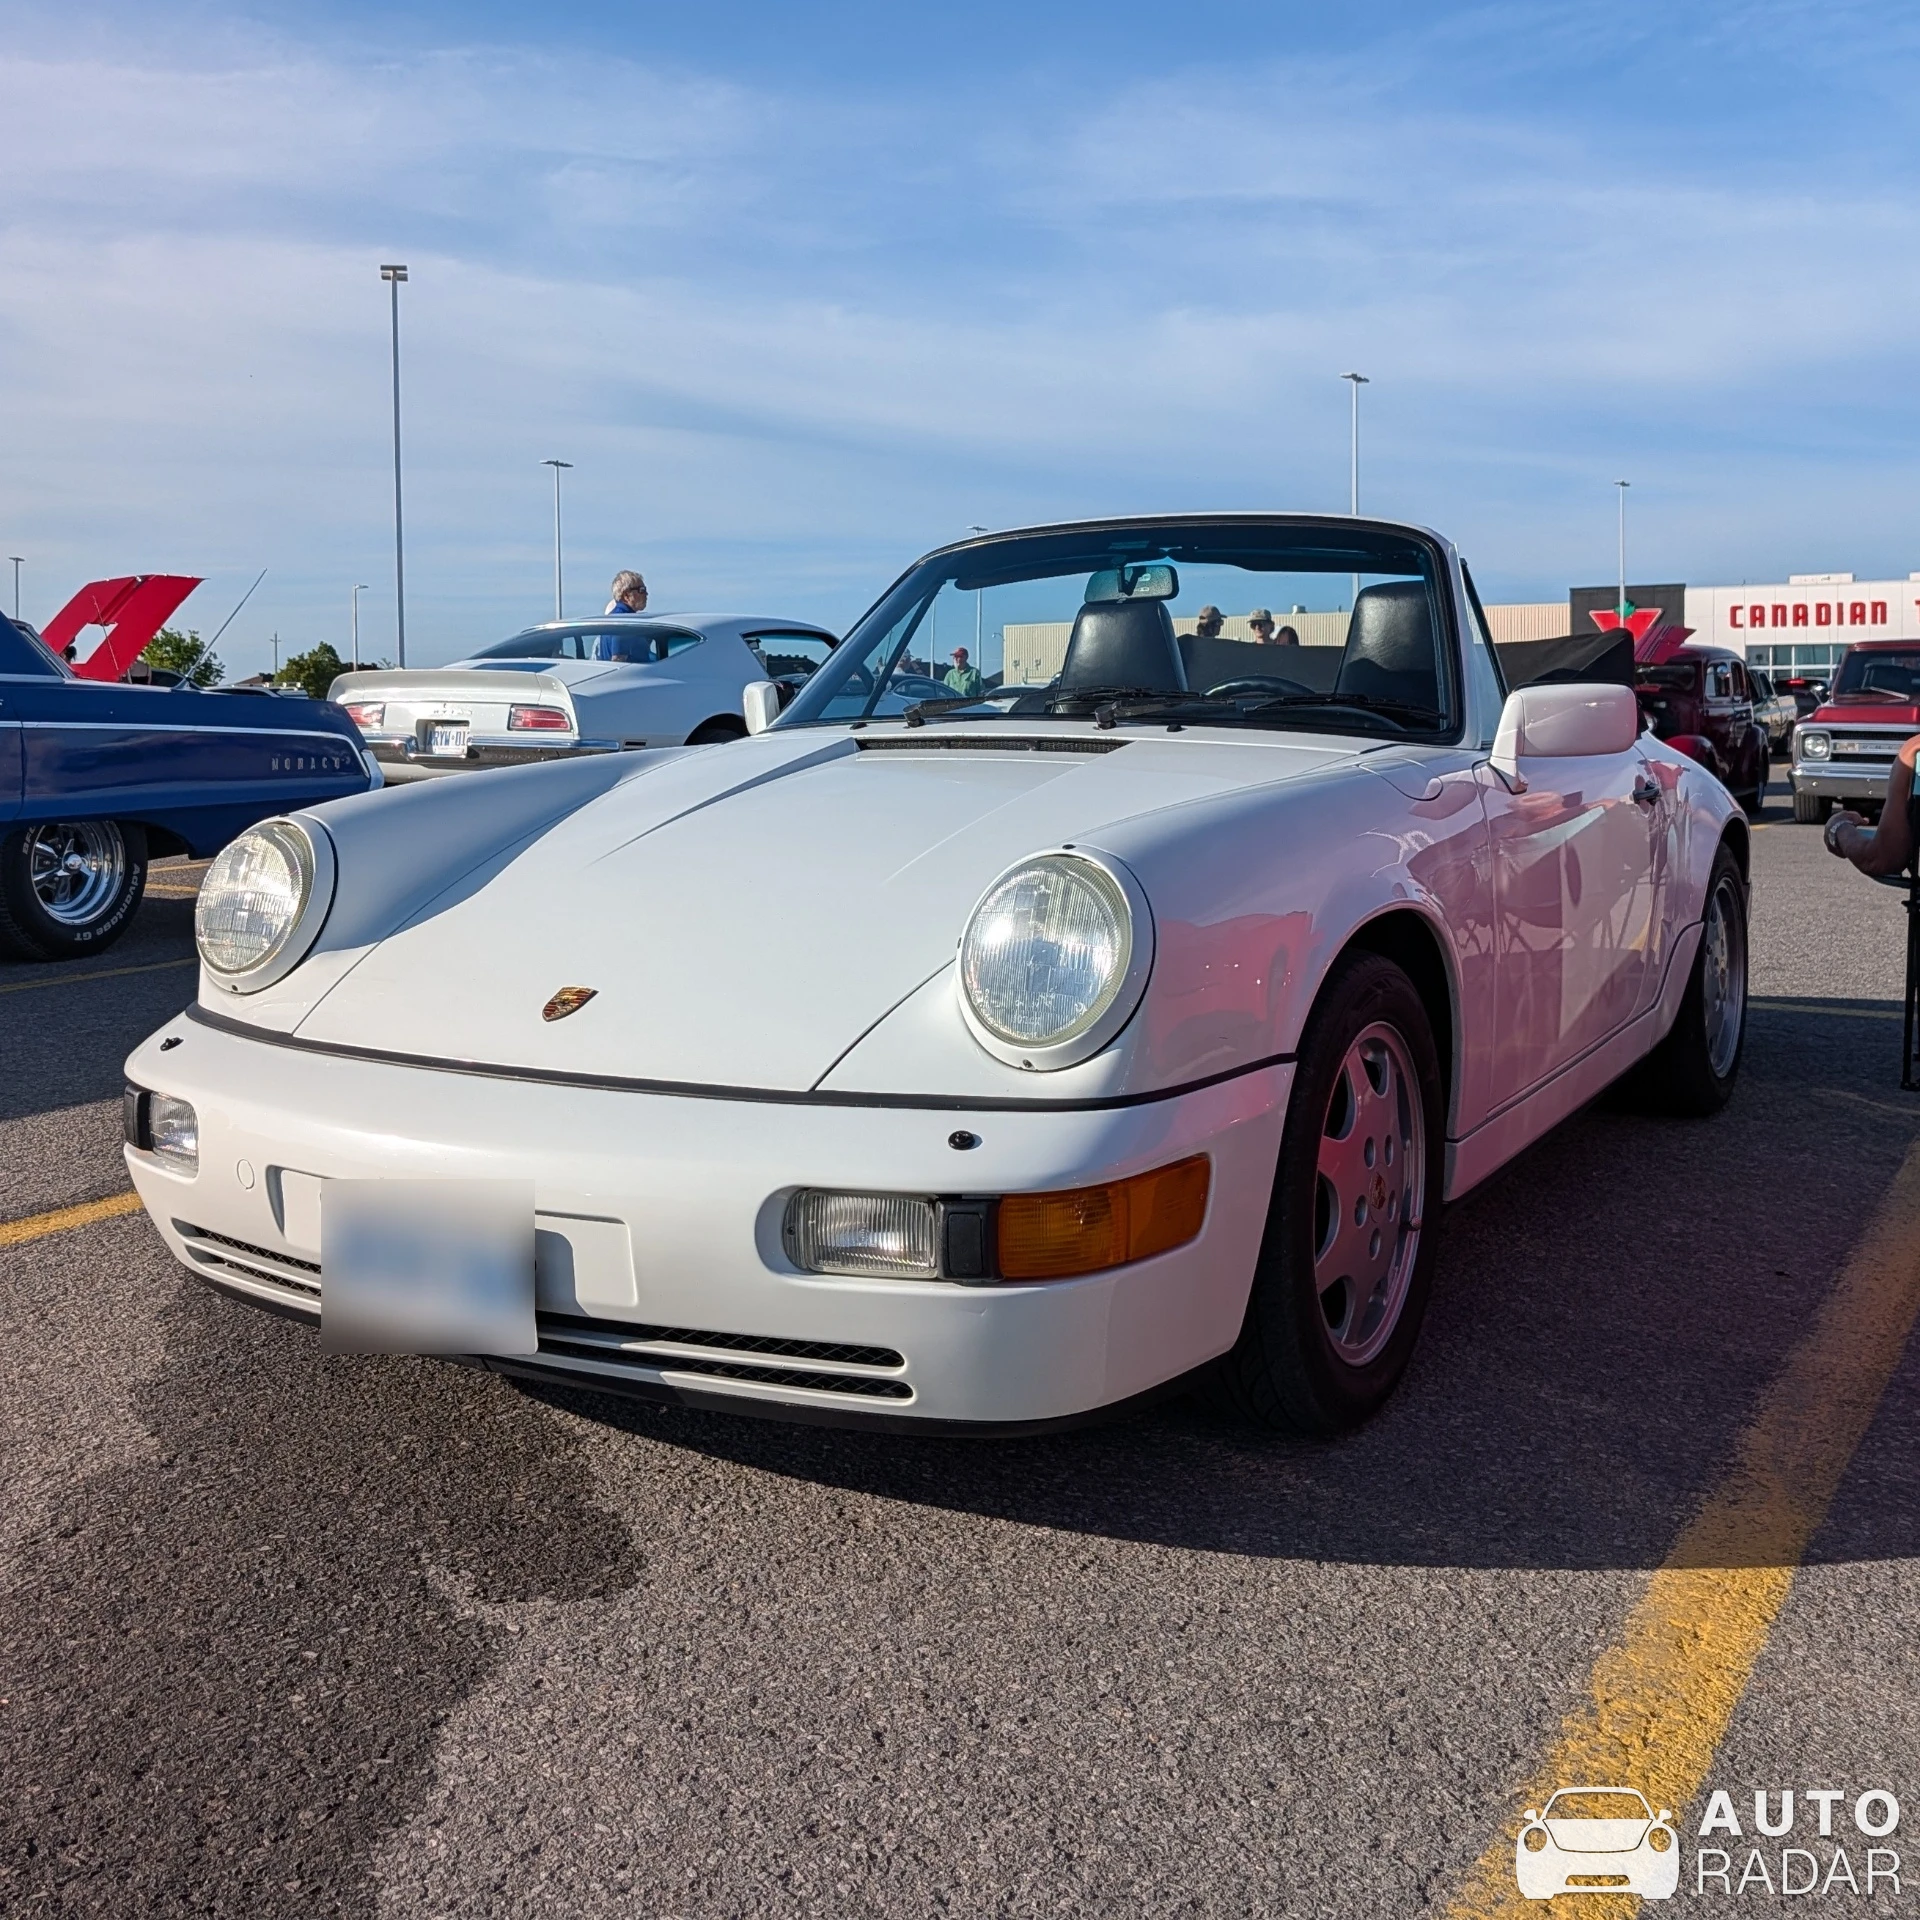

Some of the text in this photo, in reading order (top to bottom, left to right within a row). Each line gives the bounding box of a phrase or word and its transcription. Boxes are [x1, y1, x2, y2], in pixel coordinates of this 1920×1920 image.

[1730, 601, 1887, 628] CANADIAN
[271, 757, 341, 771] MONACO
[74, 863, 140, 941] Advantage GT
